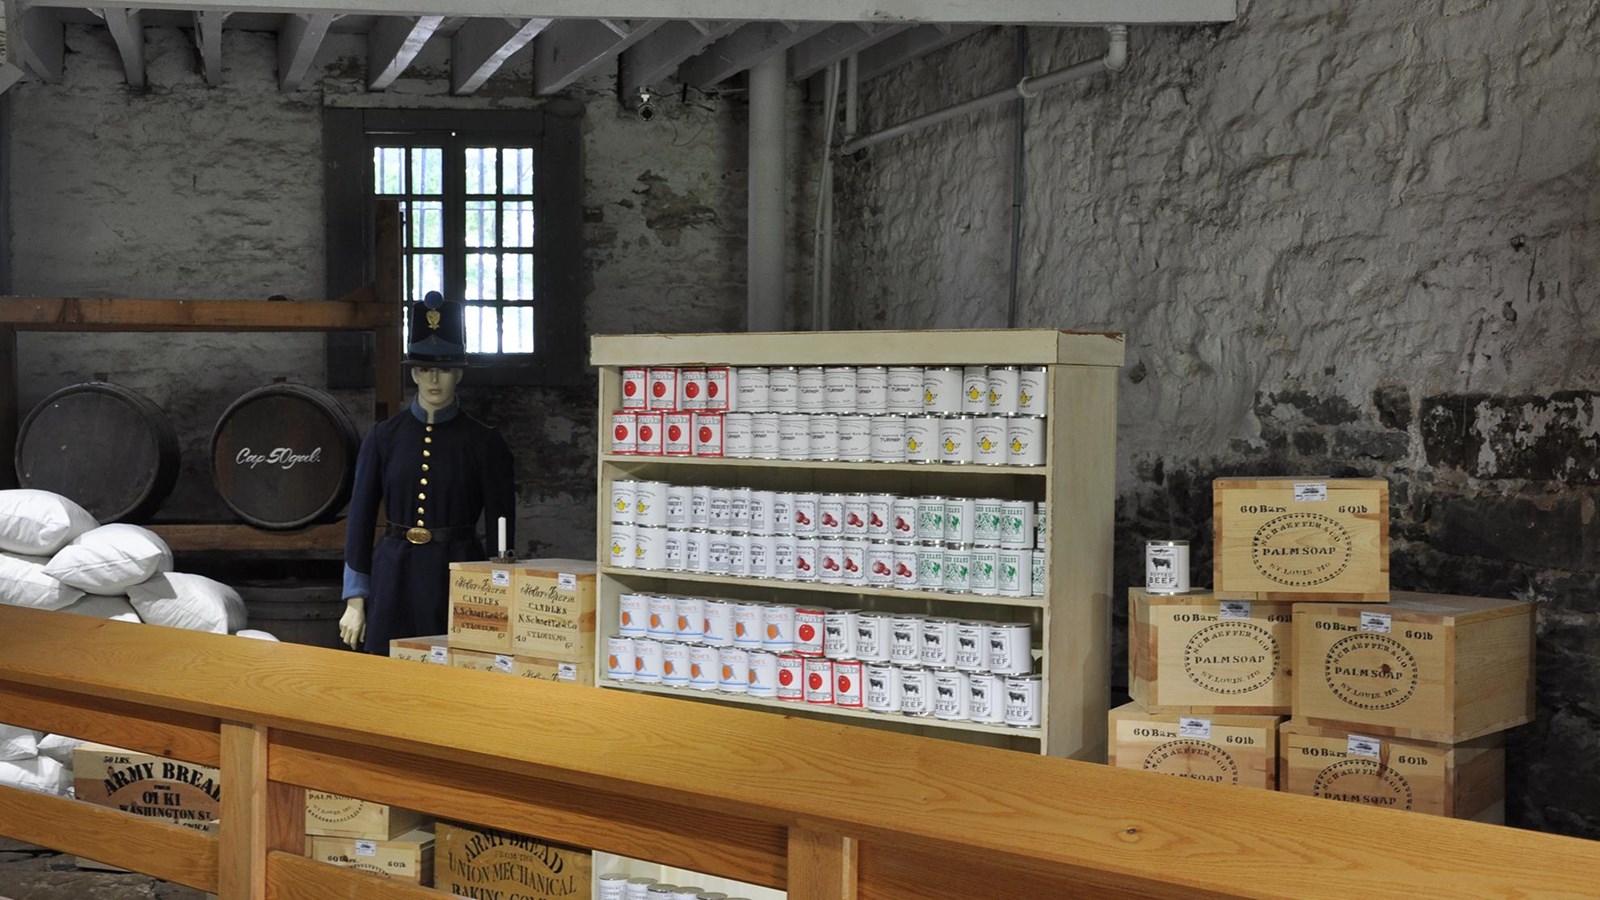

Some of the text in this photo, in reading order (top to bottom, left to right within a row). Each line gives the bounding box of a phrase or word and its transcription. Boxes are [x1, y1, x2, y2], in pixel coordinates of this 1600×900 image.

[463, 595, 499, 606] CANDLES
[528, 602, 568, 614] CANDLES
[104, 762, 154, 797] ARMY
[119, 805, 195, 820] WASHINGTON
[448, 851, 577, 897] UNION MECHANICAL
